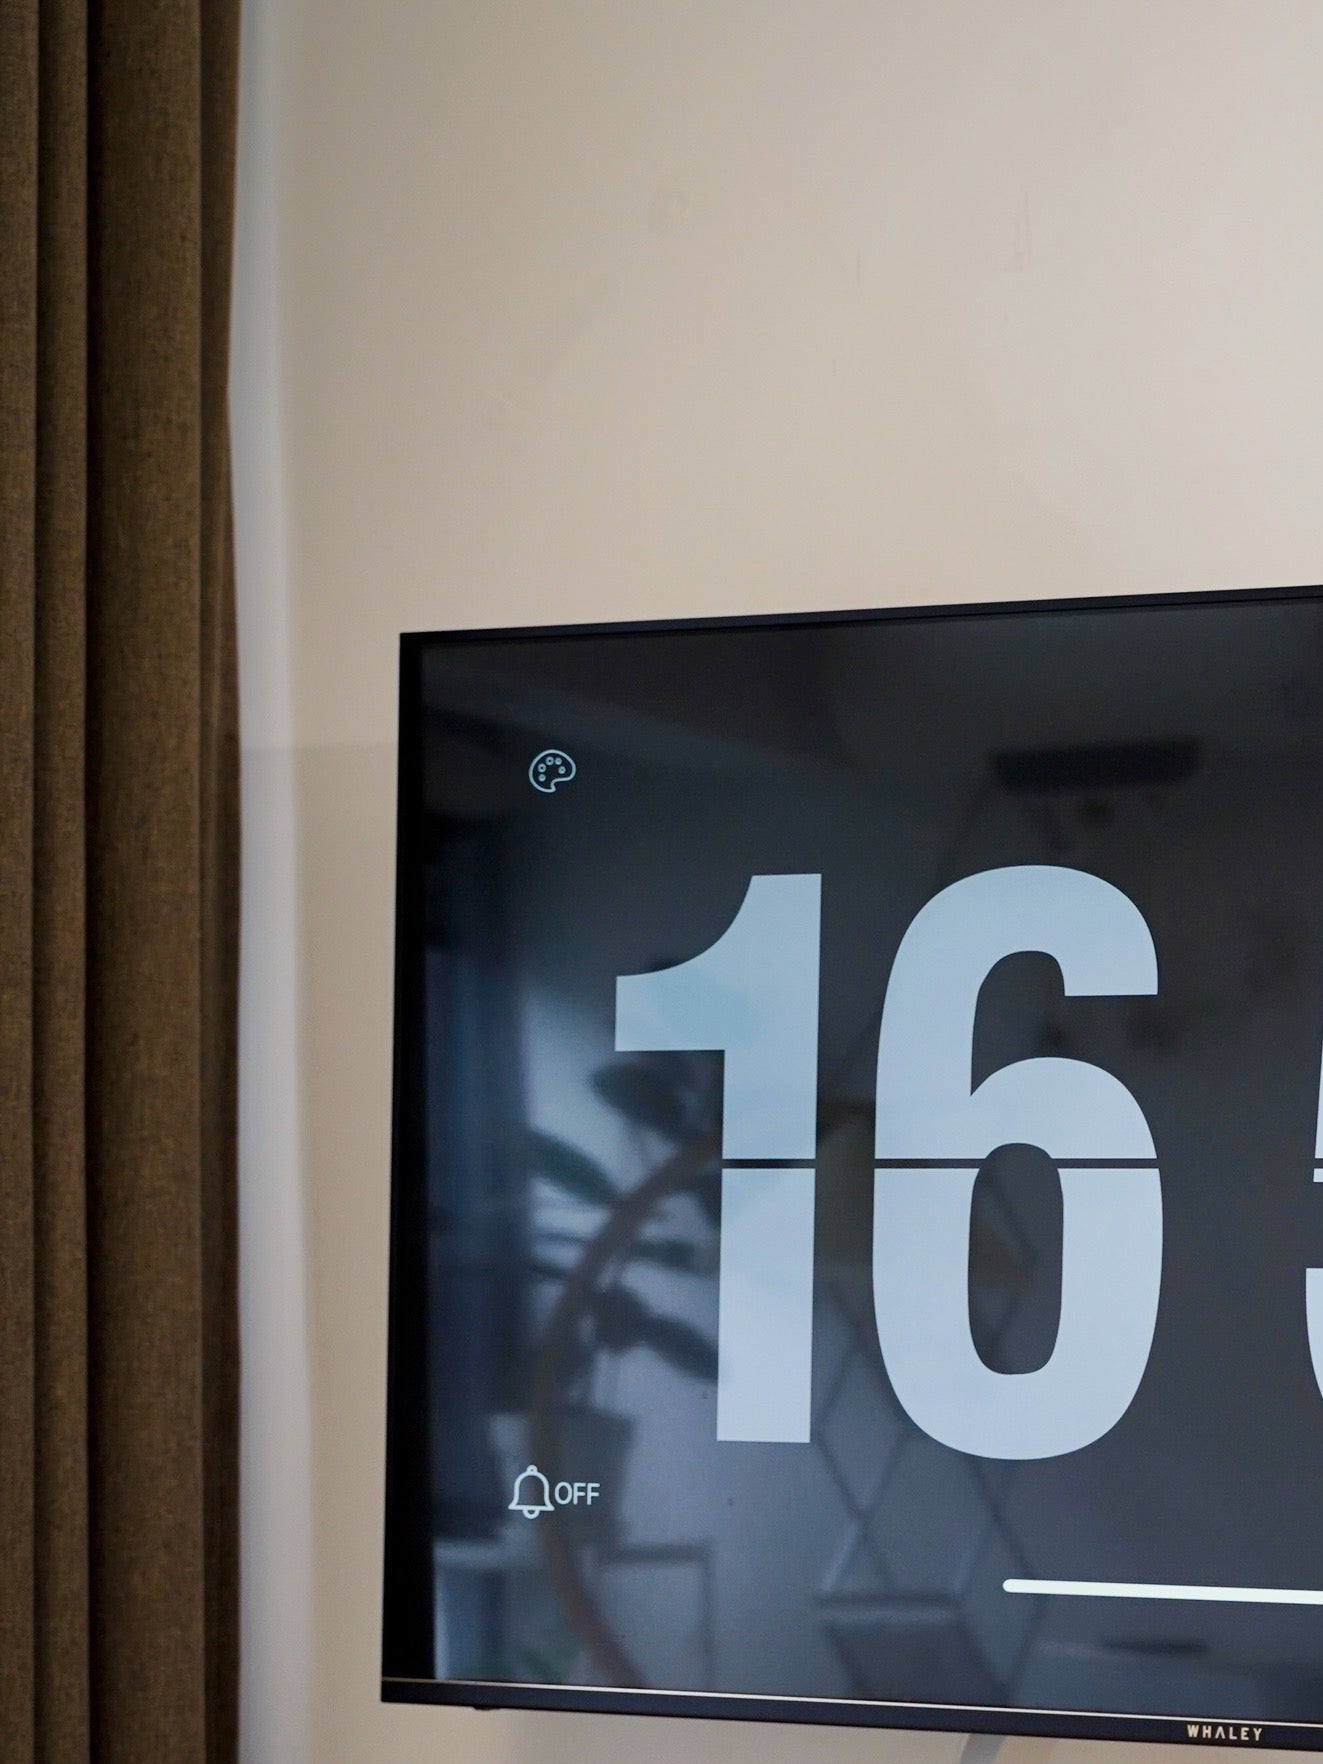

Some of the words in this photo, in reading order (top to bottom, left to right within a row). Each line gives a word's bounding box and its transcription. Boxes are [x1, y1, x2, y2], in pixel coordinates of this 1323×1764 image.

[615, 865, 1163, 1460] 16
[554, 1481, 600, 1505] OFF
[1186, 1724, 1263, 1741] WHALEY
